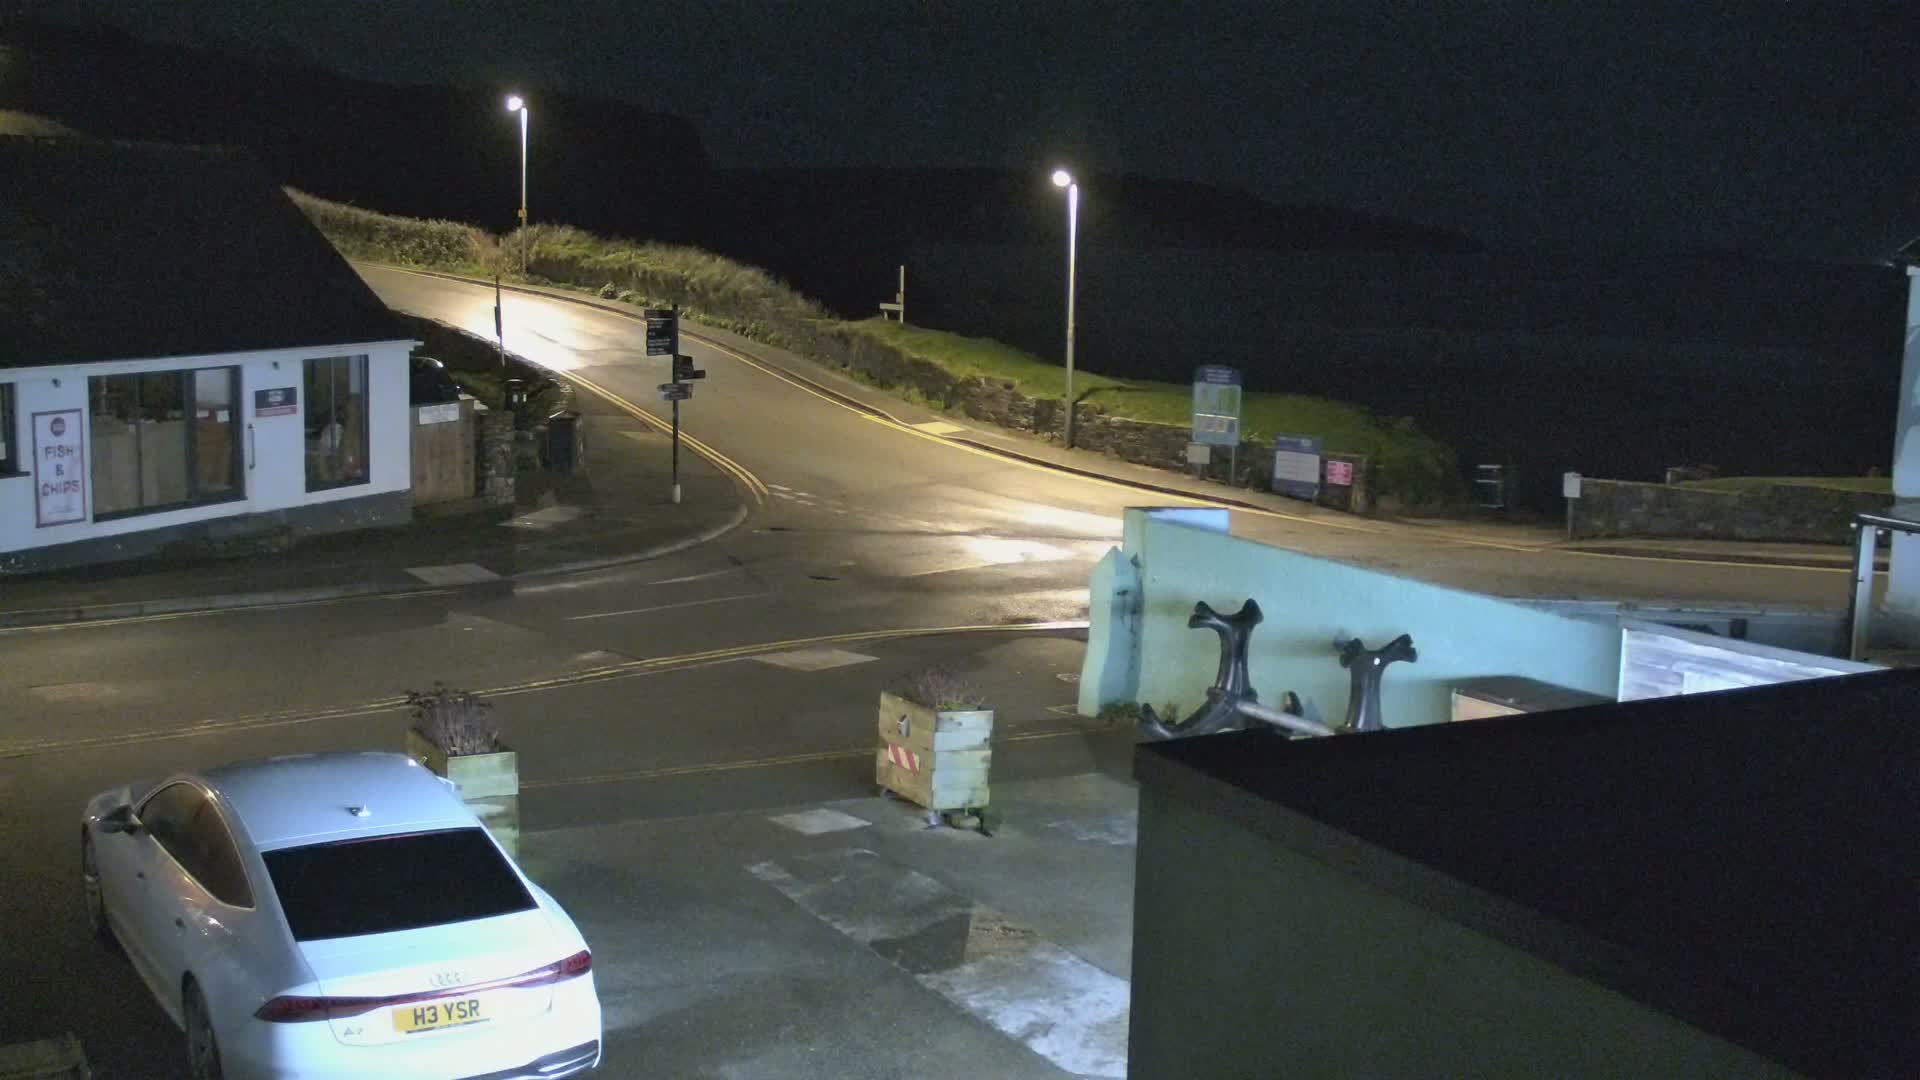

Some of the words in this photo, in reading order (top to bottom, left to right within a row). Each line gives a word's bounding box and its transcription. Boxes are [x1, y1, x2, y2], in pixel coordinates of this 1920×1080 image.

[44, 444, 74, 460] FISH
[55, 463, 65, 477] &
[41, 480, 80, 497] CHIPS
[413, 1006, 438, 1026] H3
[444, 999, 480, 1020] YSR
